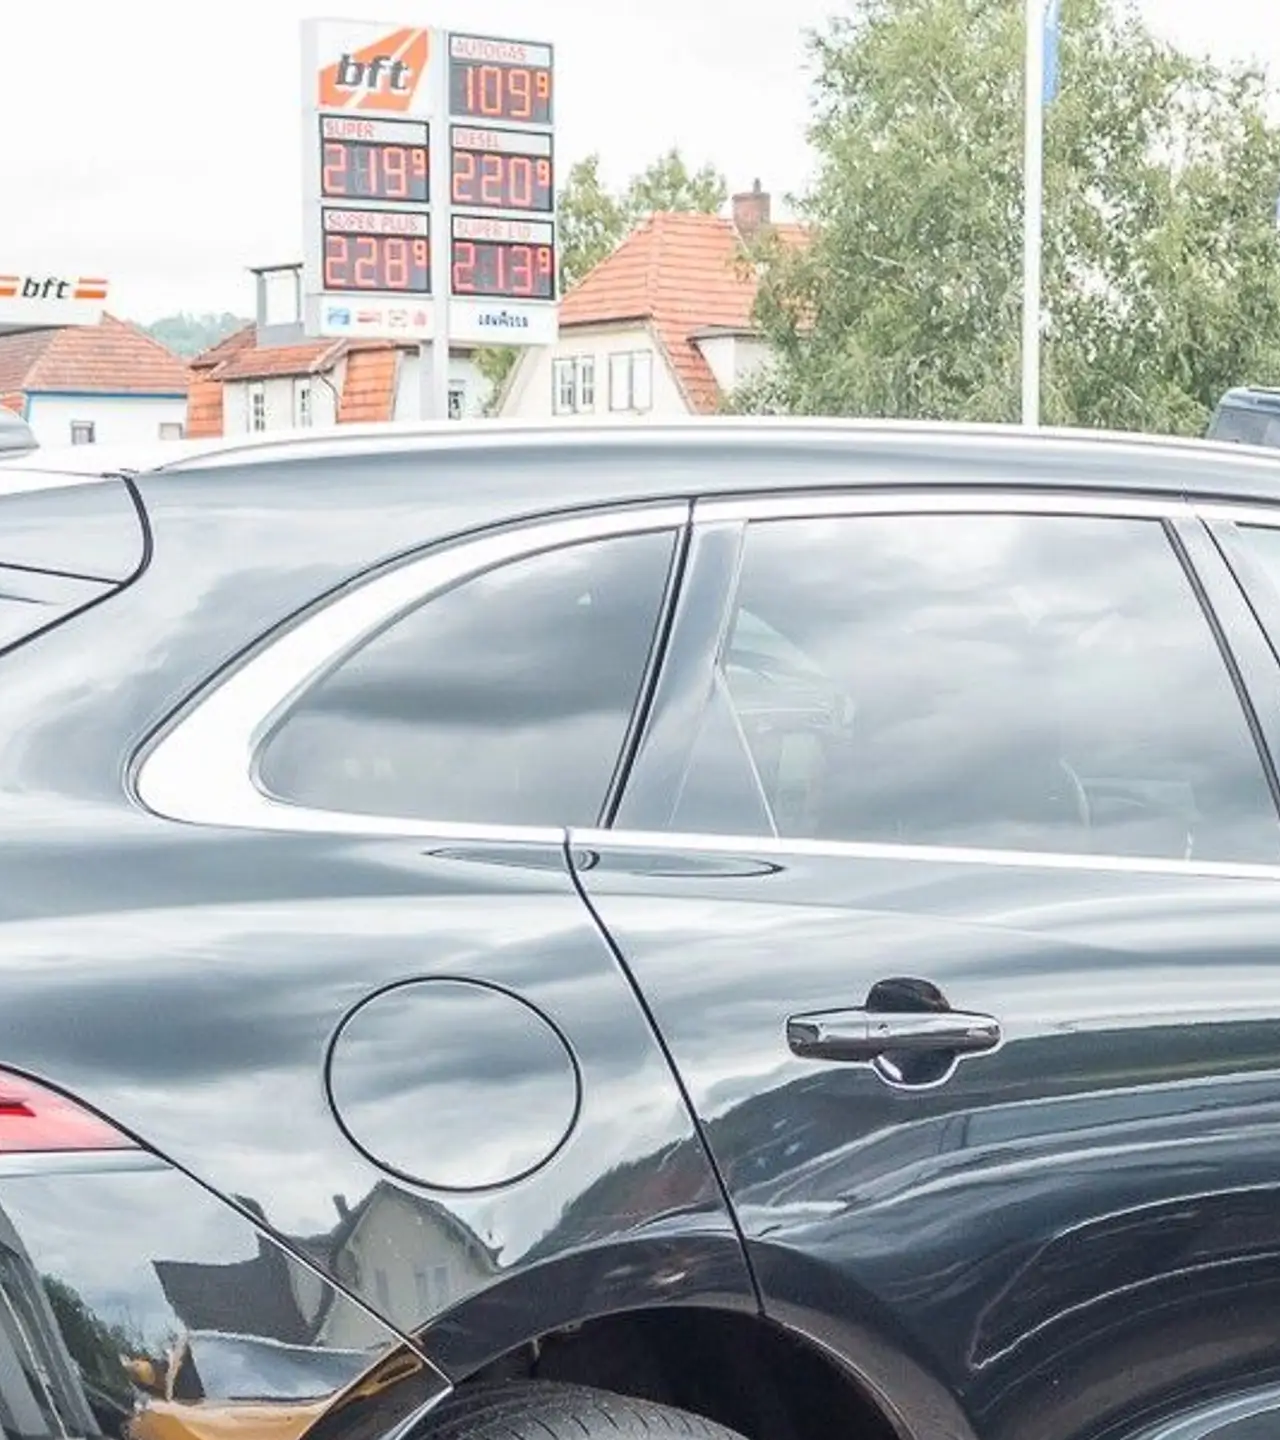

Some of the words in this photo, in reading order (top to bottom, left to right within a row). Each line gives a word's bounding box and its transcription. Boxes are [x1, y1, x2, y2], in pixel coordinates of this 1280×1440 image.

[456, 39, 527, 61] AUTOGAS
[334, 53, 410, 91] bft
[325, 122, 375, 138] SUPER
[455, 131, 500, 150] DIESEL
[22, 276, 71, 300] bft
